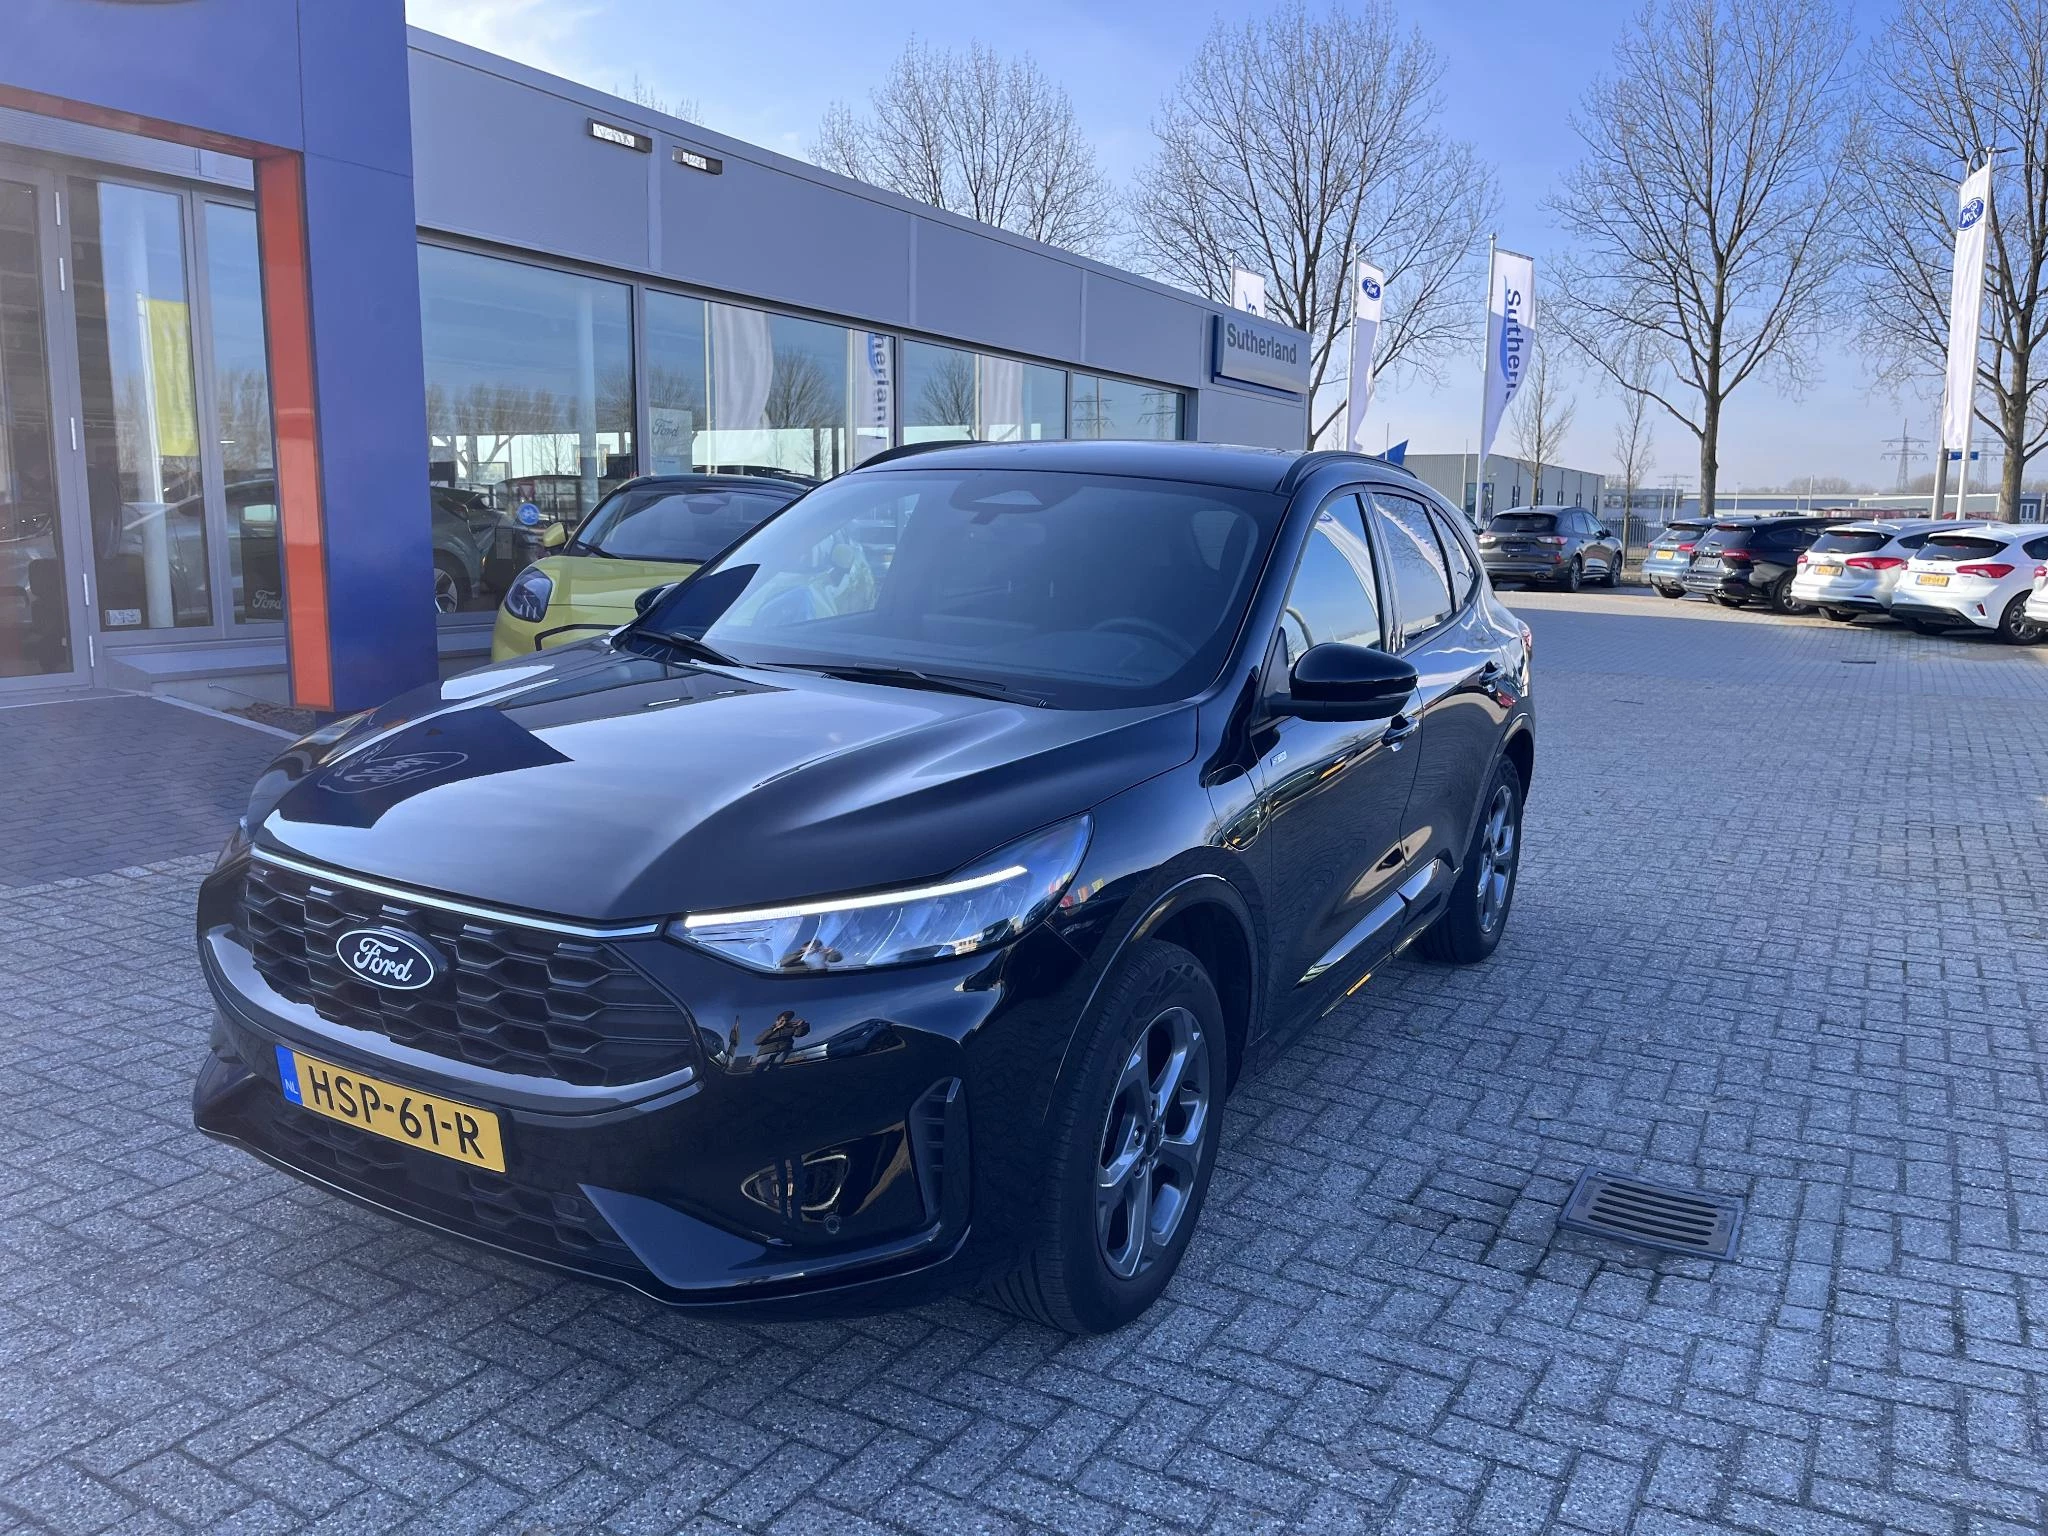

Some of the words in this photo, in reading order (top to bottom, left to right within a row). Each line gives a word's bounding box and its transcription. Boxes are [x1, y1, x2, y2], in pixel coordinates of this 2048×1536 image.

[1227, 322, 1297, 365] Sutherland
[354, 937, 414, 982] Ford
[284, 1078, 299, 1095] NL
[308, 1065, 485, 1160] HSP-61-R
